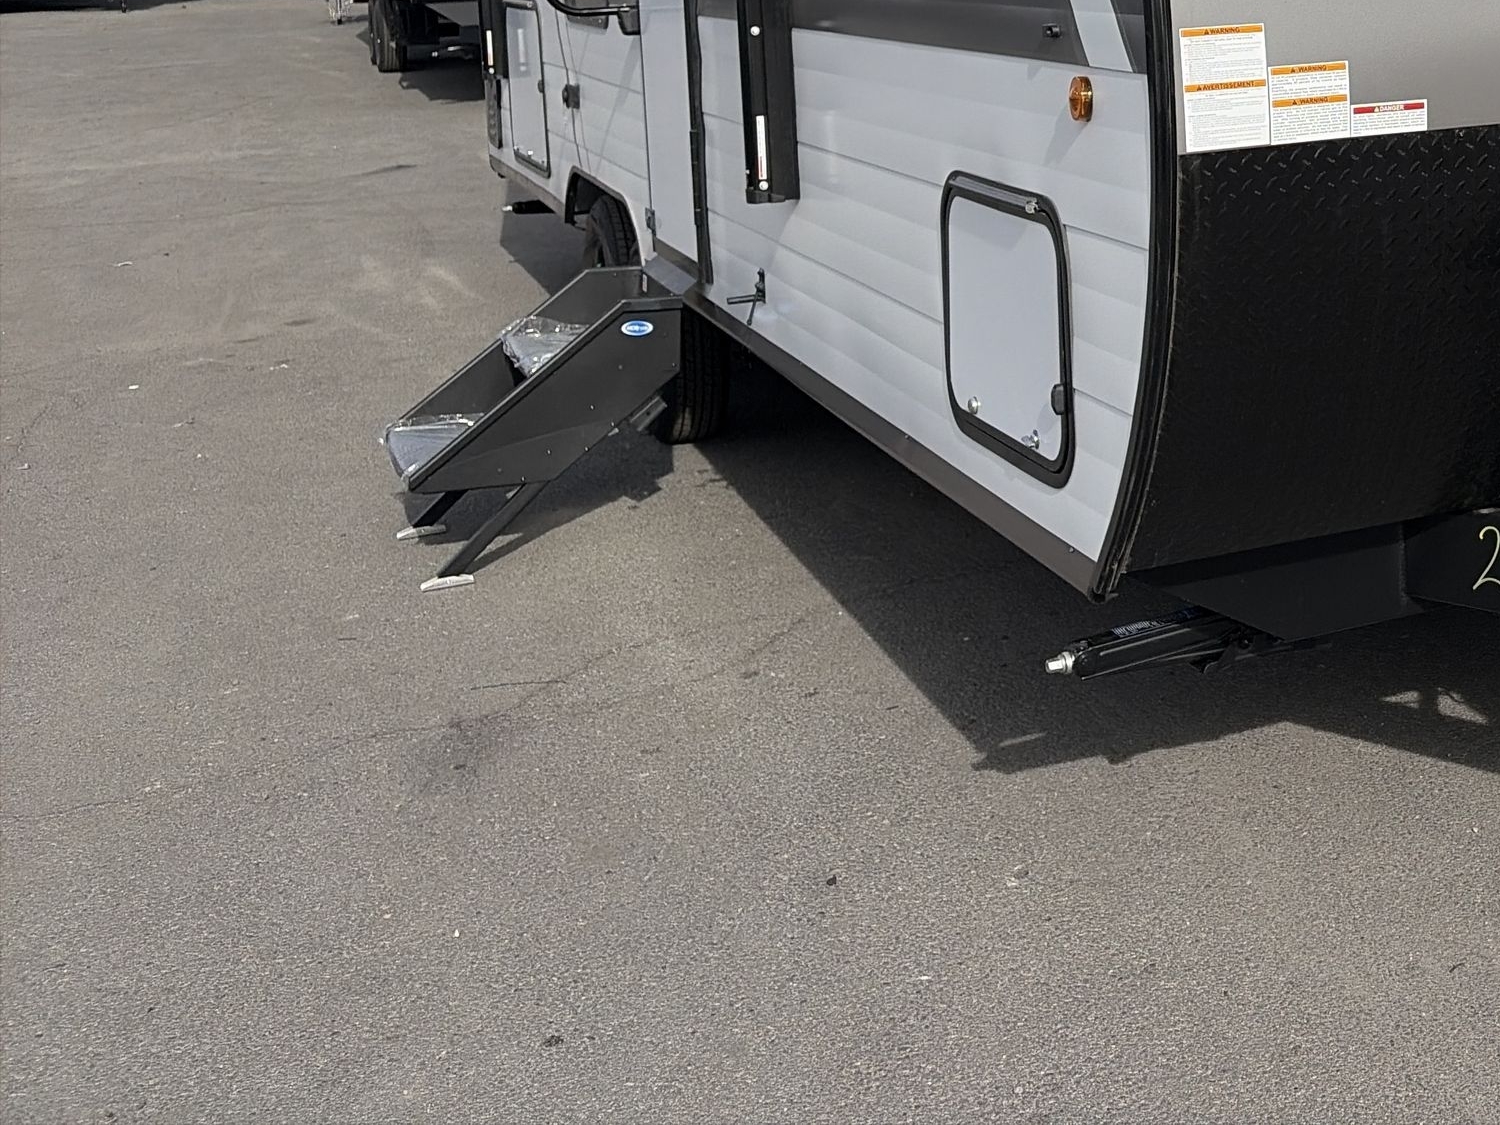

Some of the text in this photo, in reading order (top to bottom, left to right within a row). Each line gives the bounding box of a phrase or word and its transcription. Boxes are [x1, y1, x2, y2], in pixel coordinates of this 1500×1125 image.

[1210, 26, 1241, 35] WARNING
[1298, 64, 1327, 73] WARNING
[1203, 80, 1255, 91] AVERTISSEMENT
[1300, 96, 1329, 106] WARNING
[1379, 104, 1405, 112] DANGER
